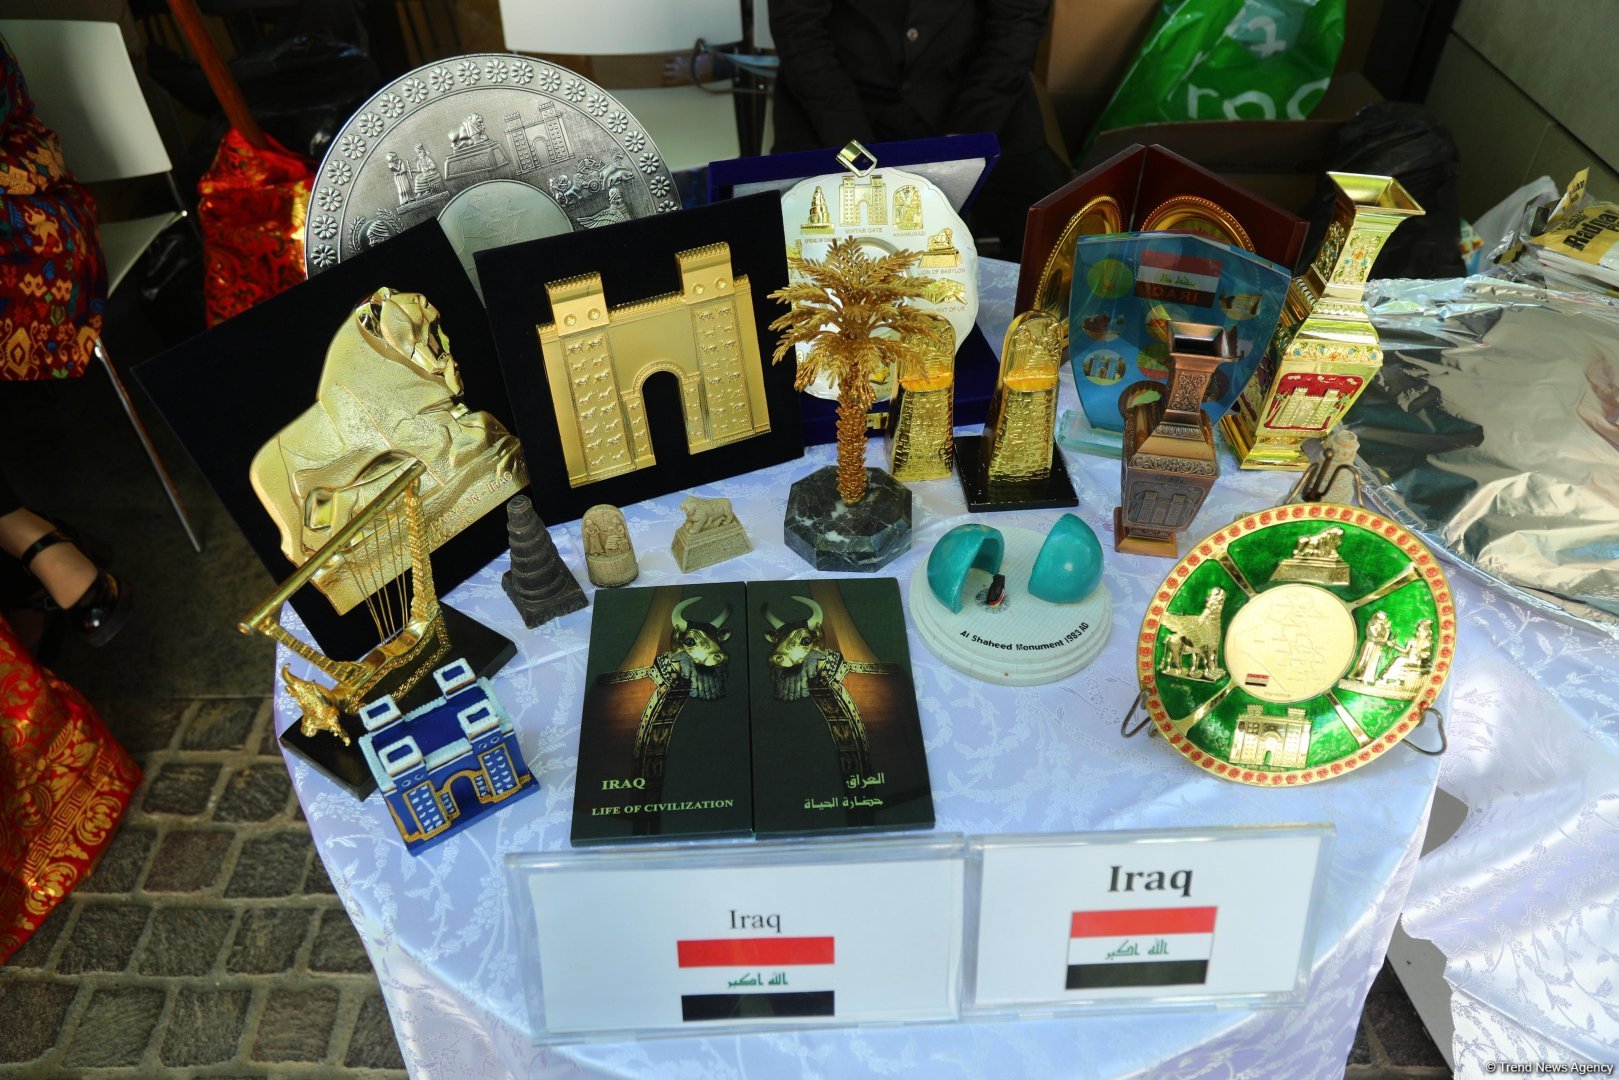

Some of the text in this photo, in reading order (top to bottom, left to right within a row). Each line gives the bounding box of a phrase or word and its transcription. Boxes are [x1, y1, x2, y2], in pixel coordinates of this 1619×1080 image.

[971, 635, 1013, 651] Shaheed
[1016, 640, 1064, 651] Monument
[1065, 629, 1082, 644] 1983
[1079, 621, 1090, 633] AD
[601, 777, 646, 790] IRAQ
[845, 772, 885, 789] العراق
[591, 799, 734, 816] LIFE OF CIVILIZATION
[804, 795, 884, 811] حضارة الحياة
[1108, 865, 1194, 898] Iraq
[729, 909, 782, 934] Iraq
